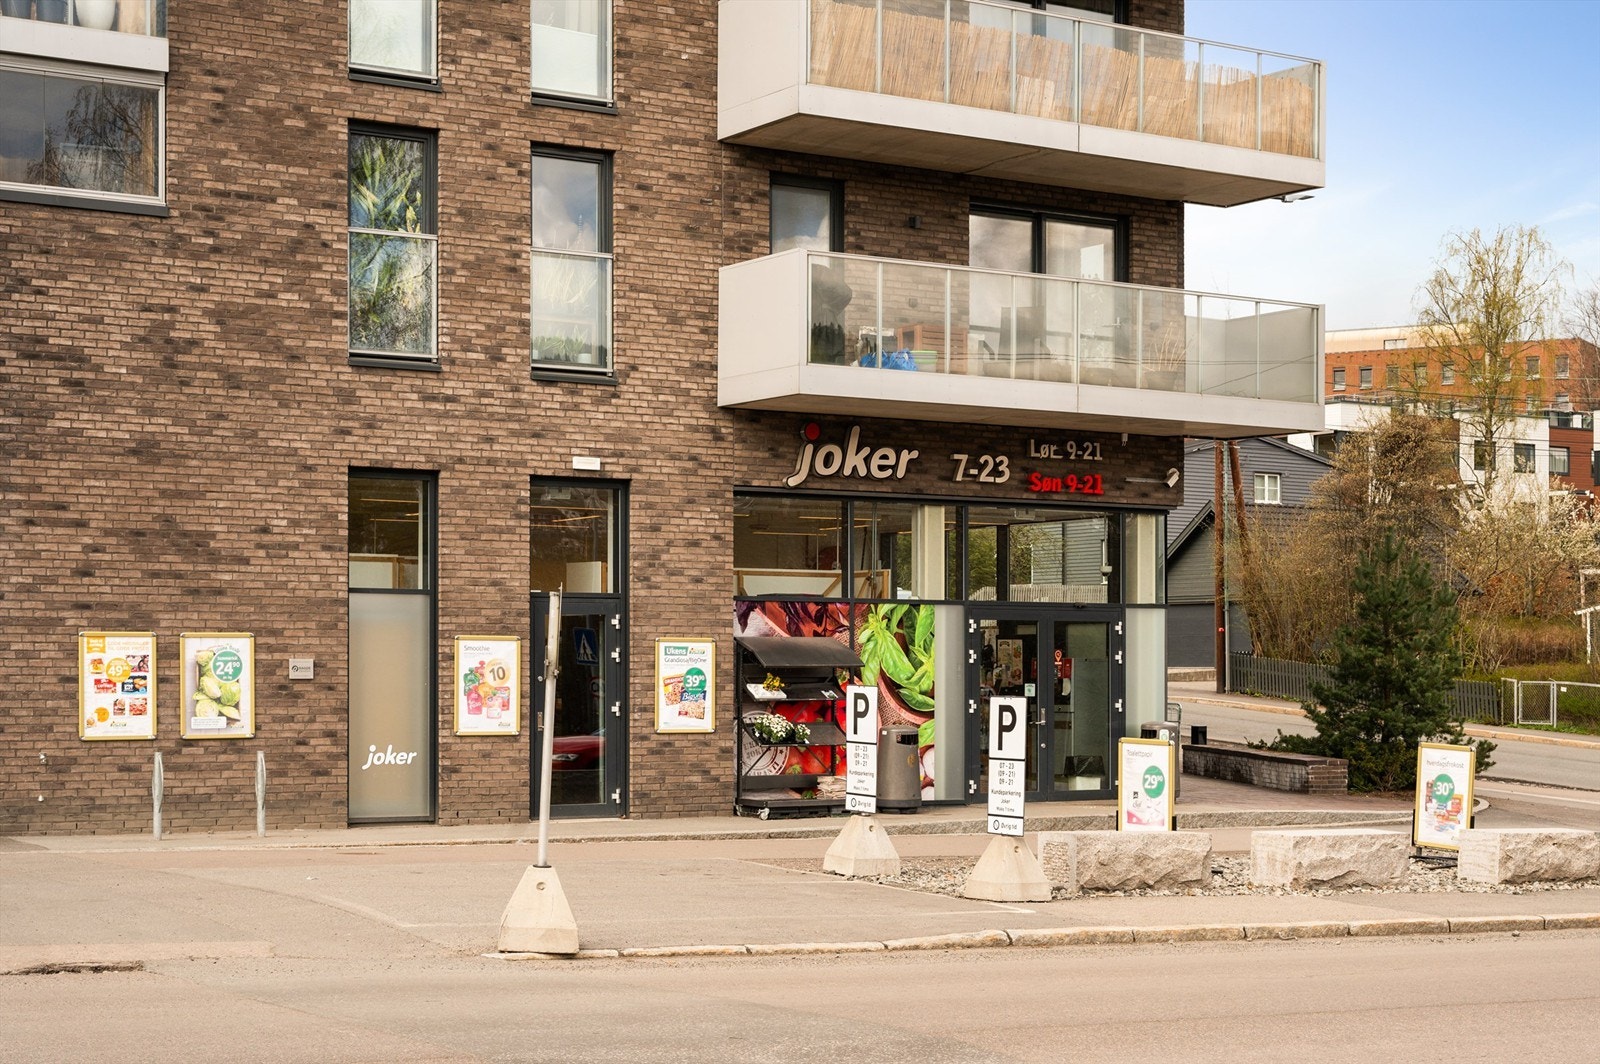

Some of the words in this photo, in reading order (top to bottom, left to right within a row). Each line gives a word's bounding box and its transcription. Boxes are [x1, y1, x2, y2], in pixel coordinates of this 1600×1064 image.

[784, 422, 919, 487] joker
[1067, 441, 1103, 461] 9-21
[952, 453, 1010, 483] 7-23
[1030, 472, 1062, 492] Søn
[1067, 474, 1104, 495] 9-21
[489, 666, 506, 681] 10
[853, 692, 870, 735] P
[998, 704, 1017, 751] P
[361, 744, 418, 770] joker
[991, 789, 1021, 798] Kundeparkering
